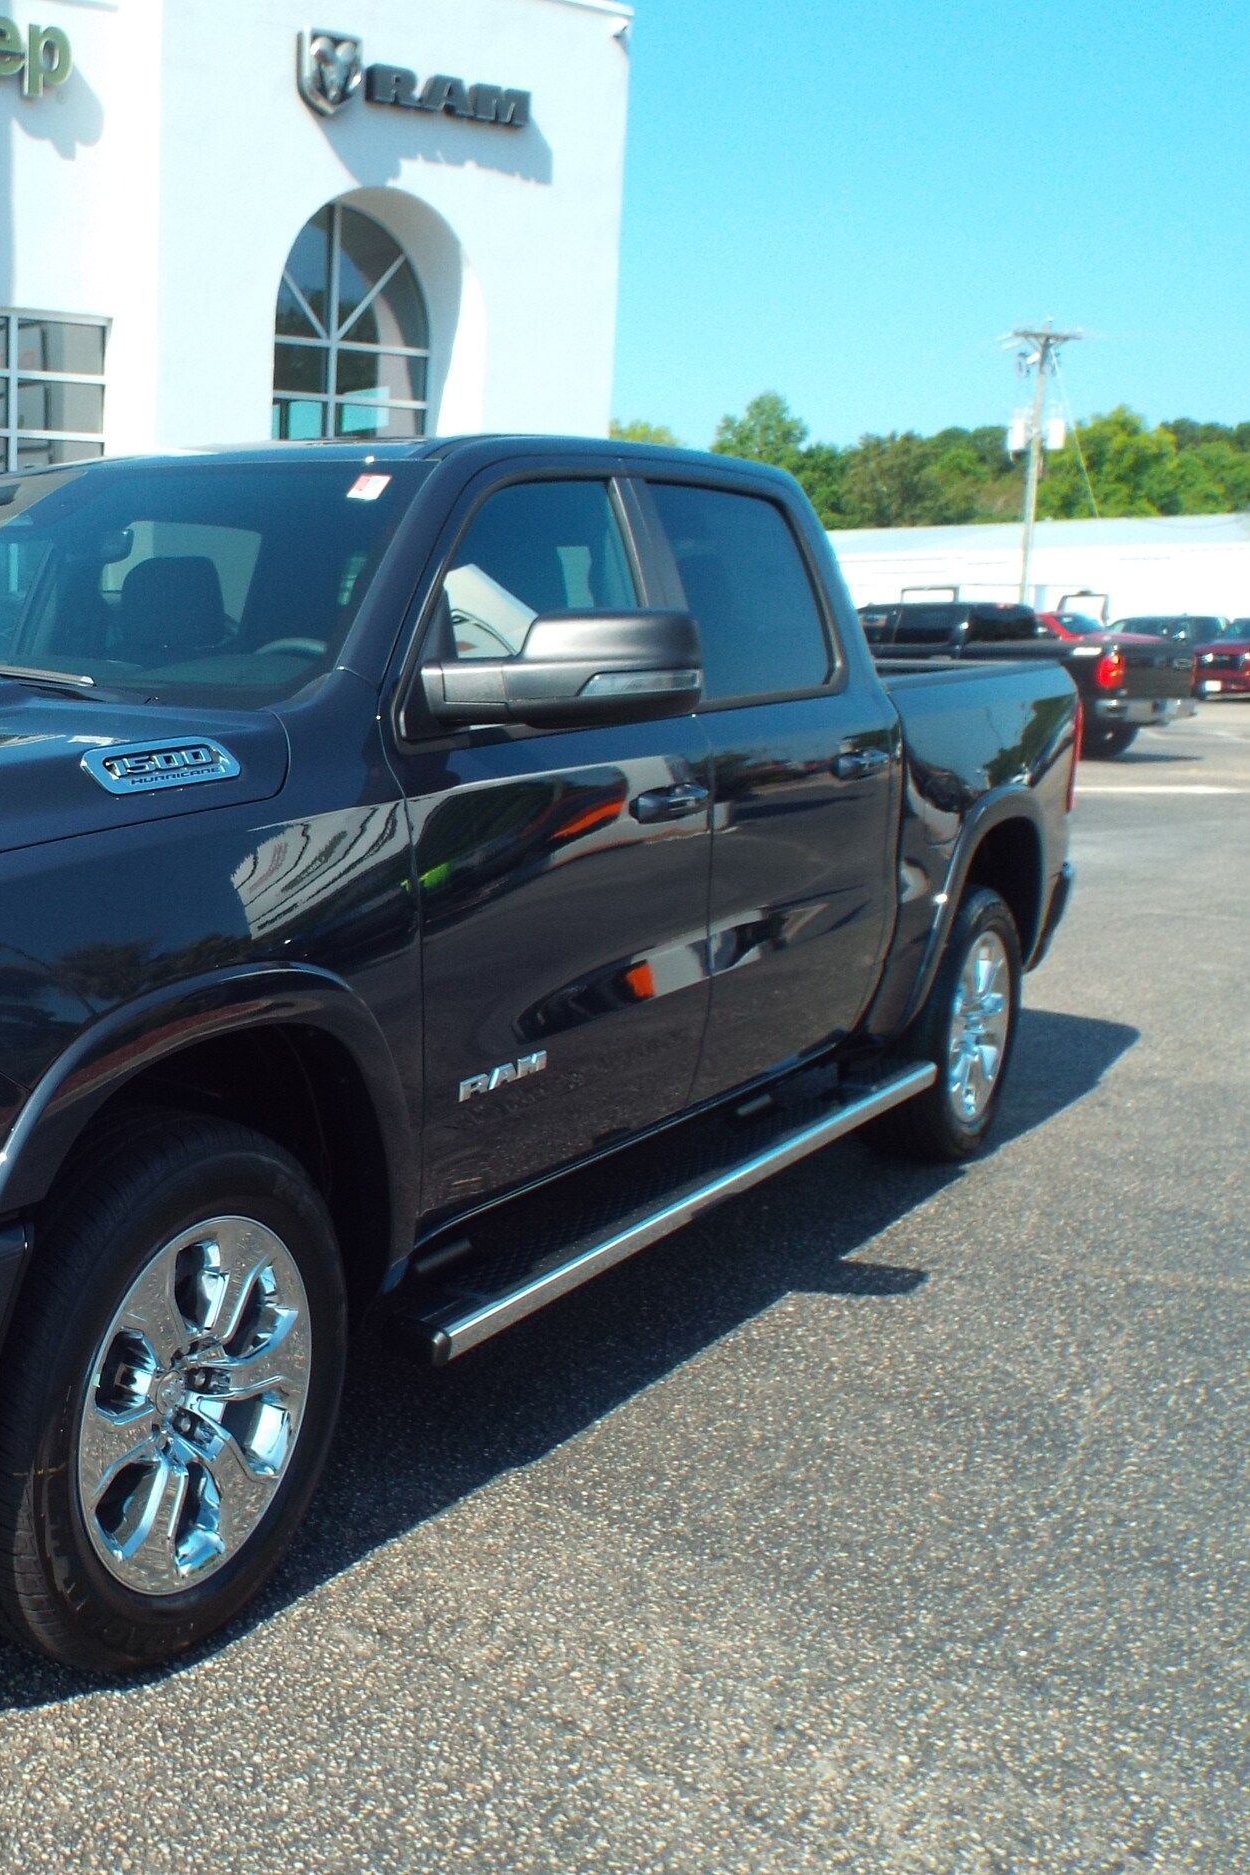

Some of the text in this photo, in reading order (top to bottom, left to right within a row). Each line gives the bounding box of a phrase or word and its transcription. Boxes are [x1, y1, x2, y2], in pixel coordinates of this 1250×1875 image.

[365, 63, 532, 127] RAM
[105, 747, 213, 778] 1500
[130, 766, 222, 786] HURRICANE
[458, 1049, 548, 1103] RAM
